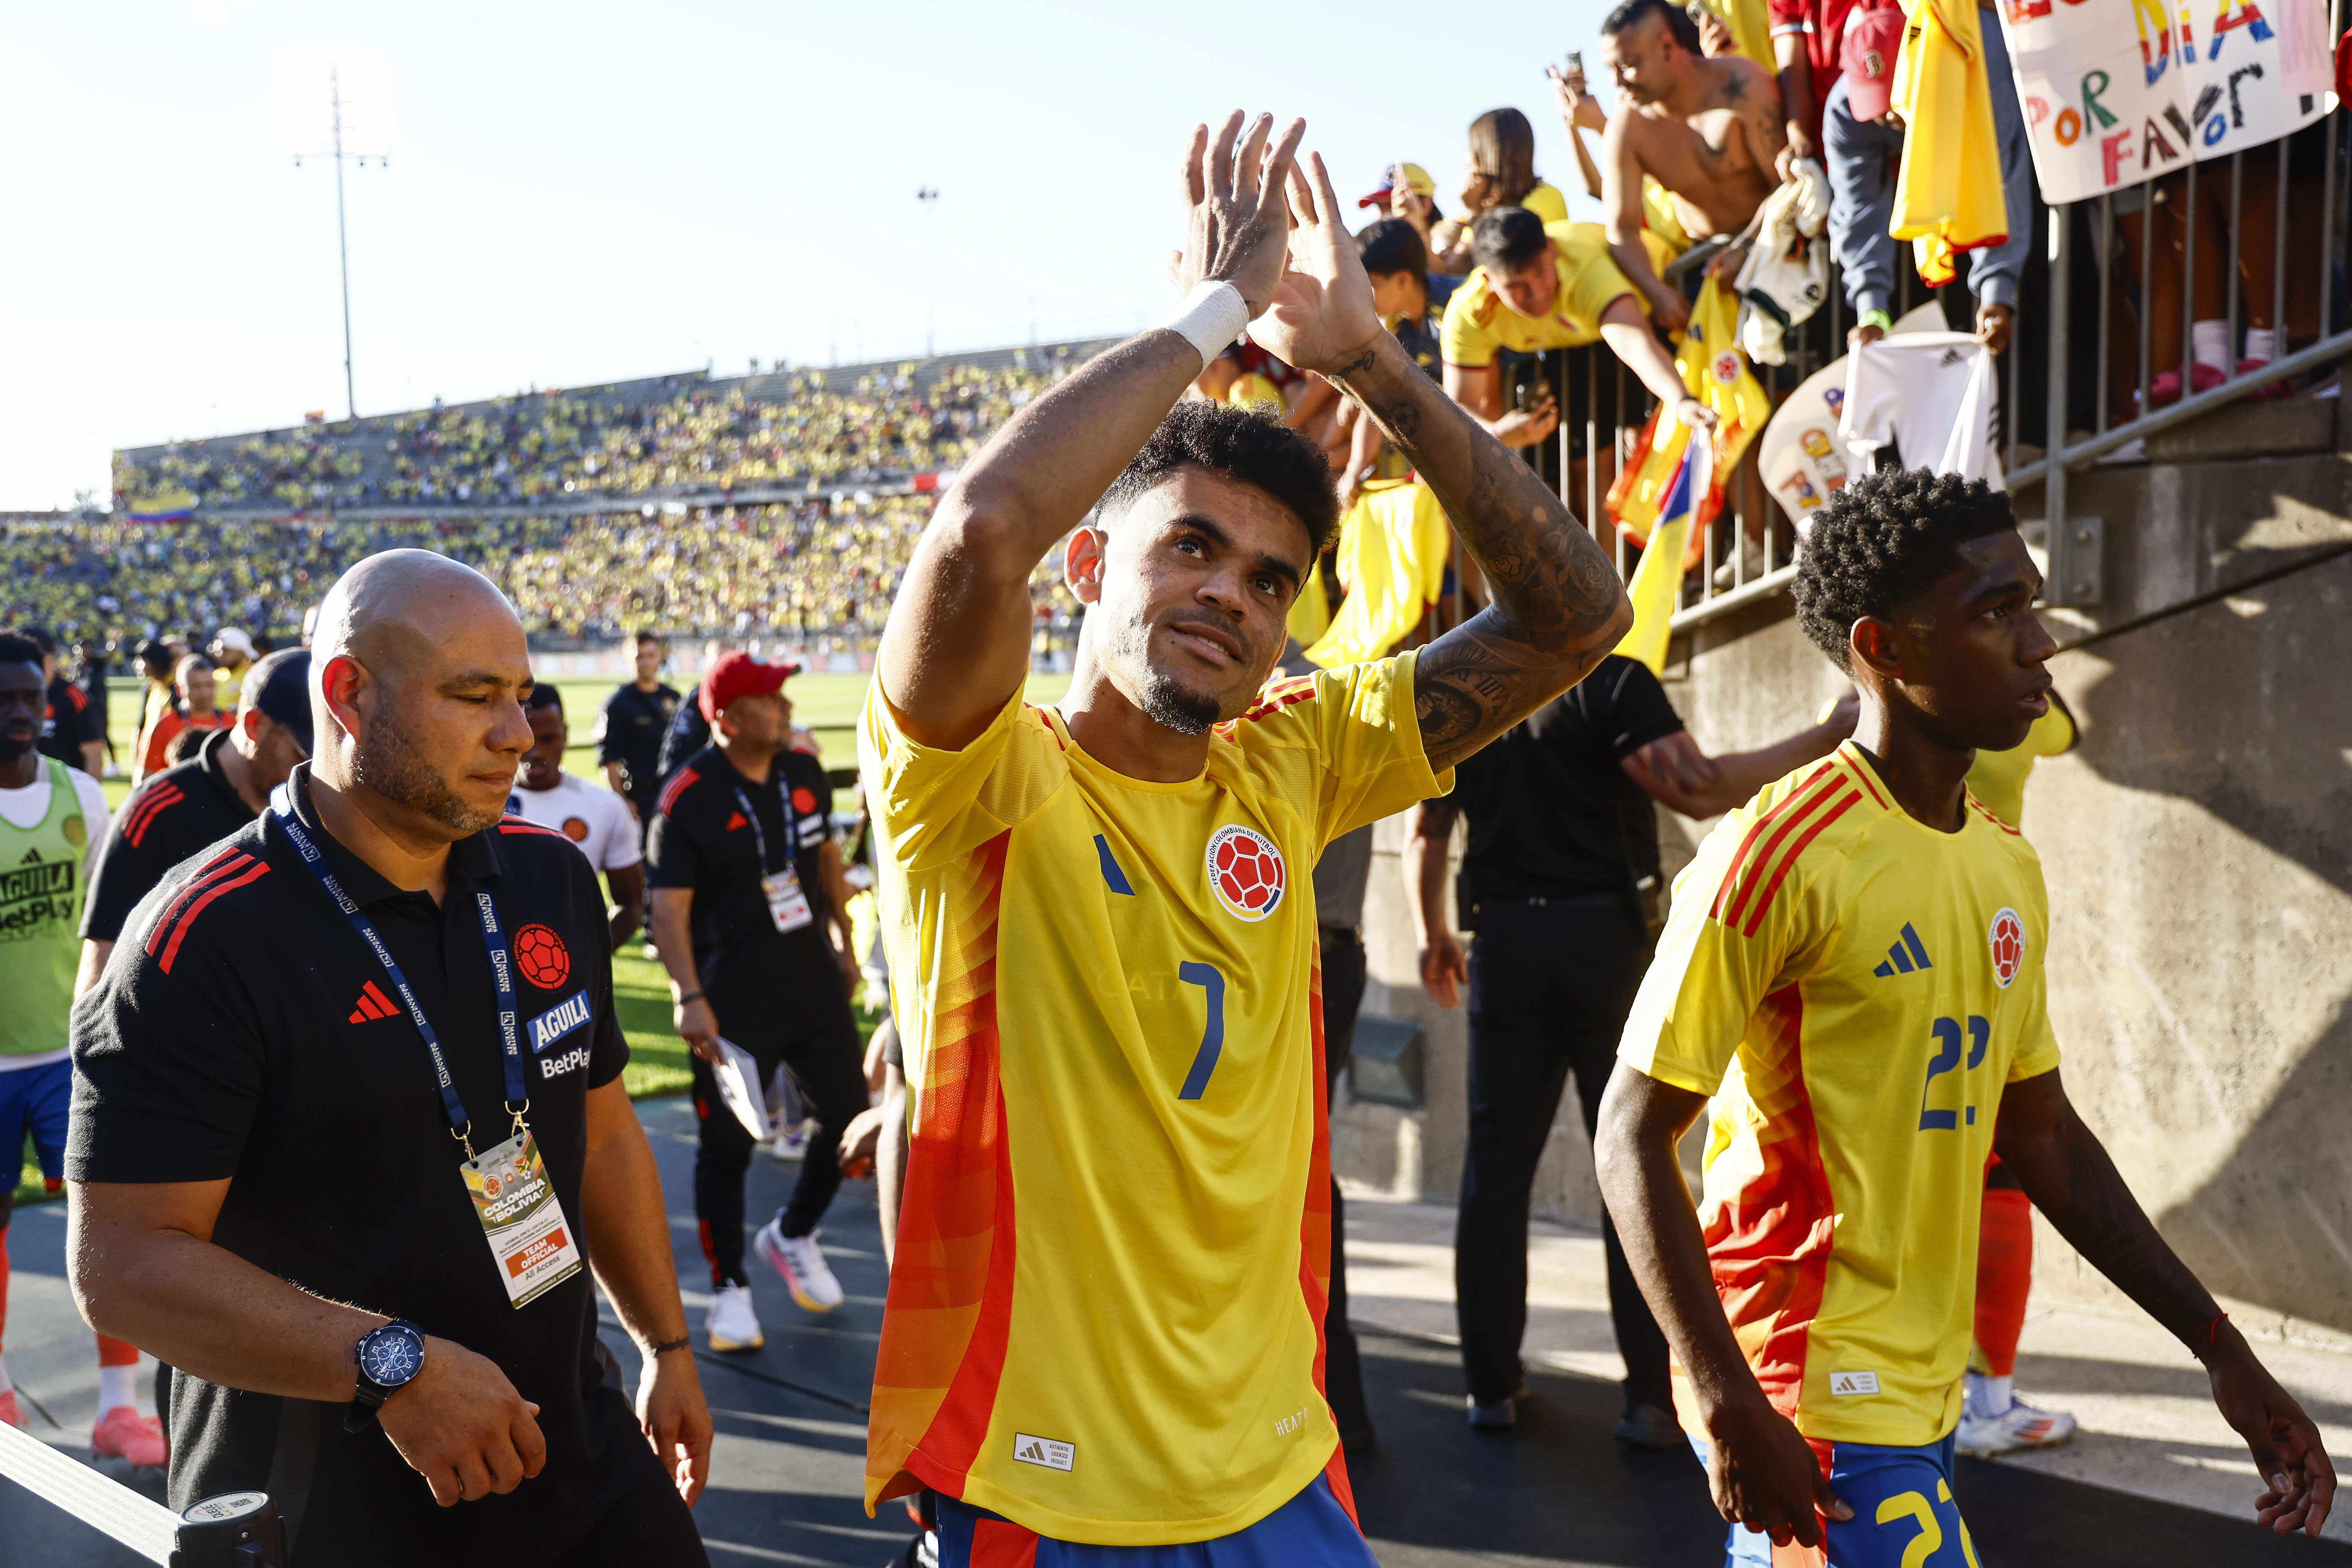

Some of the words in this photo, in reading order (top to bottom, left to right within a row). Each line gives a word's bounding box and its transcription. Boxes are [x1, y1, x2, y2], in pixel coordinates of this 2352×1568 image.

[1862, 50, 1885, 78] B
[285, 826, 305, 849] MASTERS
[290, 822, 311, 848] EVENTS
[1209, 844, 1218, 885] FEDERACIÓN
[1214, 827, 1246, 844] COLOMBIANA
[1255, 835, 1276, 857] FÚTBOL
[323, 877, 342, 902] MASTERS
[328, 875, 348, 900] EVENTS
[0, 898, 74, 929] etPly
[535, 995, 590, 1049] AGUILA
[1178, 960, 1225, 1100] 7
[484, 1178, 546, 1217] COLOMBIA
[495, 1192, 542, 1222] BOLIVIA
[521, 1243, 559, 1269] OFFICIAL
[523, 1239, 547, 1257] TEAM
[526, 1269, 535, 1281] All
[537, 1255, 561, 1274] Access
[203, 1504, 224, 1518] QUEUE
